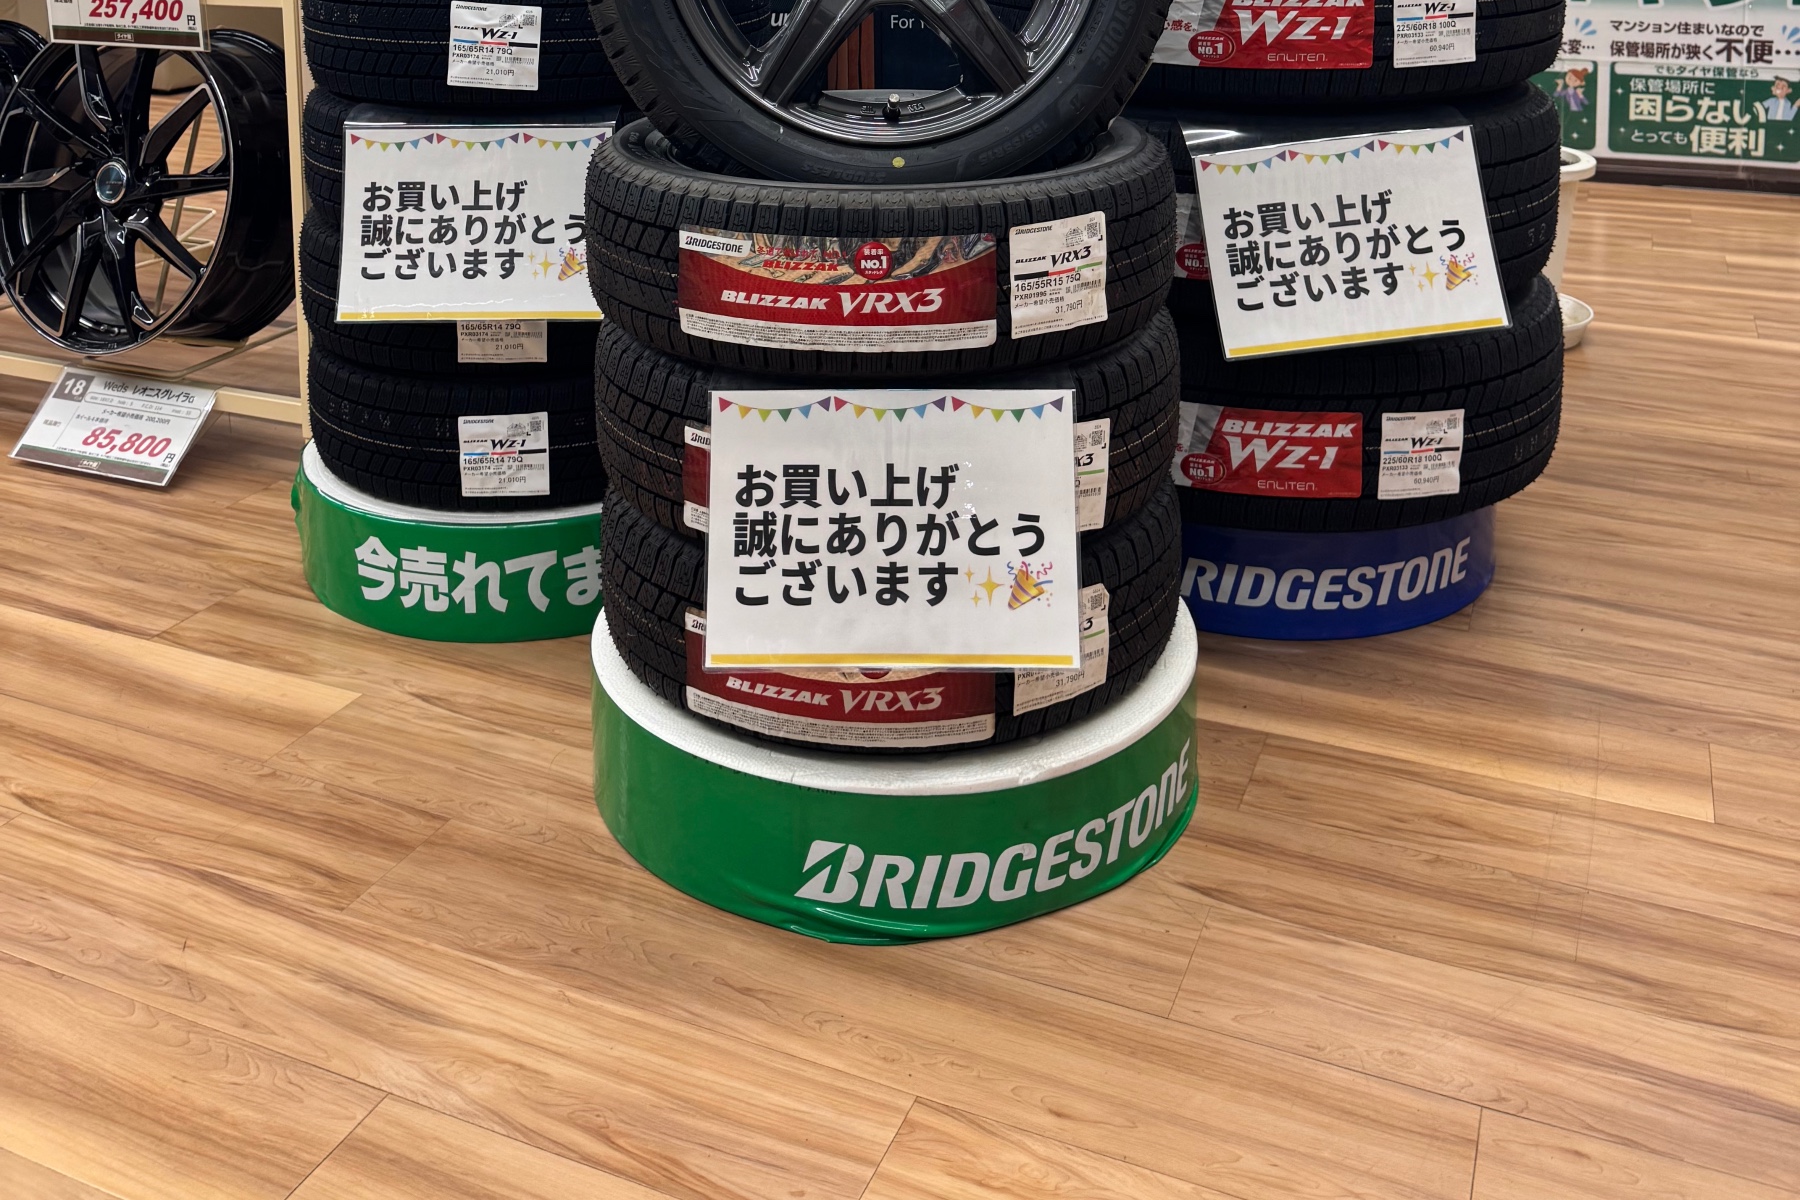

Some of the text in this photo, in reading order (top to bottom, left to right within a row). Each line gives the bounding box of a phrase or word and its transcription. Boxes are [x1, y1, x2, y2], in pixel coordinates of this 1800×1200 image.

[1424, 2, 1456, 15] WZ-1
[186, 14, 196, 26] 円
[890, 15, 914, 29] For
[1233, 9, 1351, 47] WZ-1
[1397, 21, 1457, 32] 225/60R18 100Q
[1610, 20, 1764, 37] マンション住まいなので
[481, 27, 518, 39] WZ-1
[453, 45, 513, 55] 165/65R14 79Q
[1197, 43, 1223, 55] NO.1
[1267, 53, 1328, 62] ENLITEN
[486, 68, 515, 76] 21,010円
[1655, 64, 1759, 78] でもタイヤ保管なら
[1629, 78, 1715, 96] 保管場所に
[1628, 93, 1767, 124] 困らない
[1631, 125, 1766, 157] とっても便利
[362, 180, 528, 212] お買い上げ
[1222, 189, 1393, 241] お買い上げ
[360, 213, 586, 246] 誠にありがとう
[1014, 225, 1053, 235] BRIDGESTONE
[685, 235, 744, 254] BRIDGESTONE
[1226, 219, 1466, 277] 誠にありがとう
[361, 248, 524, 280] ございます
[861, 256, 887, 269] NO.1
[1050, 245, 1092, 268] VRX3
[762, 260, 839, 272] BLIZZAK
[1014, 273, 1081, 292] 165/55R15 75Q
[1237, 262, 1404, 311] ございます
[721, 287, 946, 317] BLIZZAK VRX3
[1055, 300, 1083, 314] 31,790円
[461, 323, 503, 331] 165/65R14
[64, 378, 86, 395] 18
[103, 380, 129, 393] Weds
[1221, 419, 1357, 439] BLIZZAK
[82, 427, 172, 457] 85,800
[163, 453, 176, 464] 円
[490, 438, 527, 450] WZ-1
[1411, 436, 1444, 449] WZ-1
[463, 457, 505, 465] 165/65R14
[1224, 435, 1341, 473] WZ-1
[1383, 454, 1443, 465] 225/60R18 100Q
[1189, 465, 1216, 478] NO.1
[735, 463, 960, 509] お買い上げ
[1257, 479, 1317, 491] ENLITEN
[733, 511, 1046, 558] 誠にありがとう
[354, 535, 602, 613] 今売れてま
[1181, 537, 1471, 610] RIDGESTONE
[735, 561, 960, 607] ございます
[1056, 670, 1085, 687] 31,790円
[725, 676, 946, 715] BLIZZAK VRX3
[794, 739, 1190, 909] BRIDGESTONE
